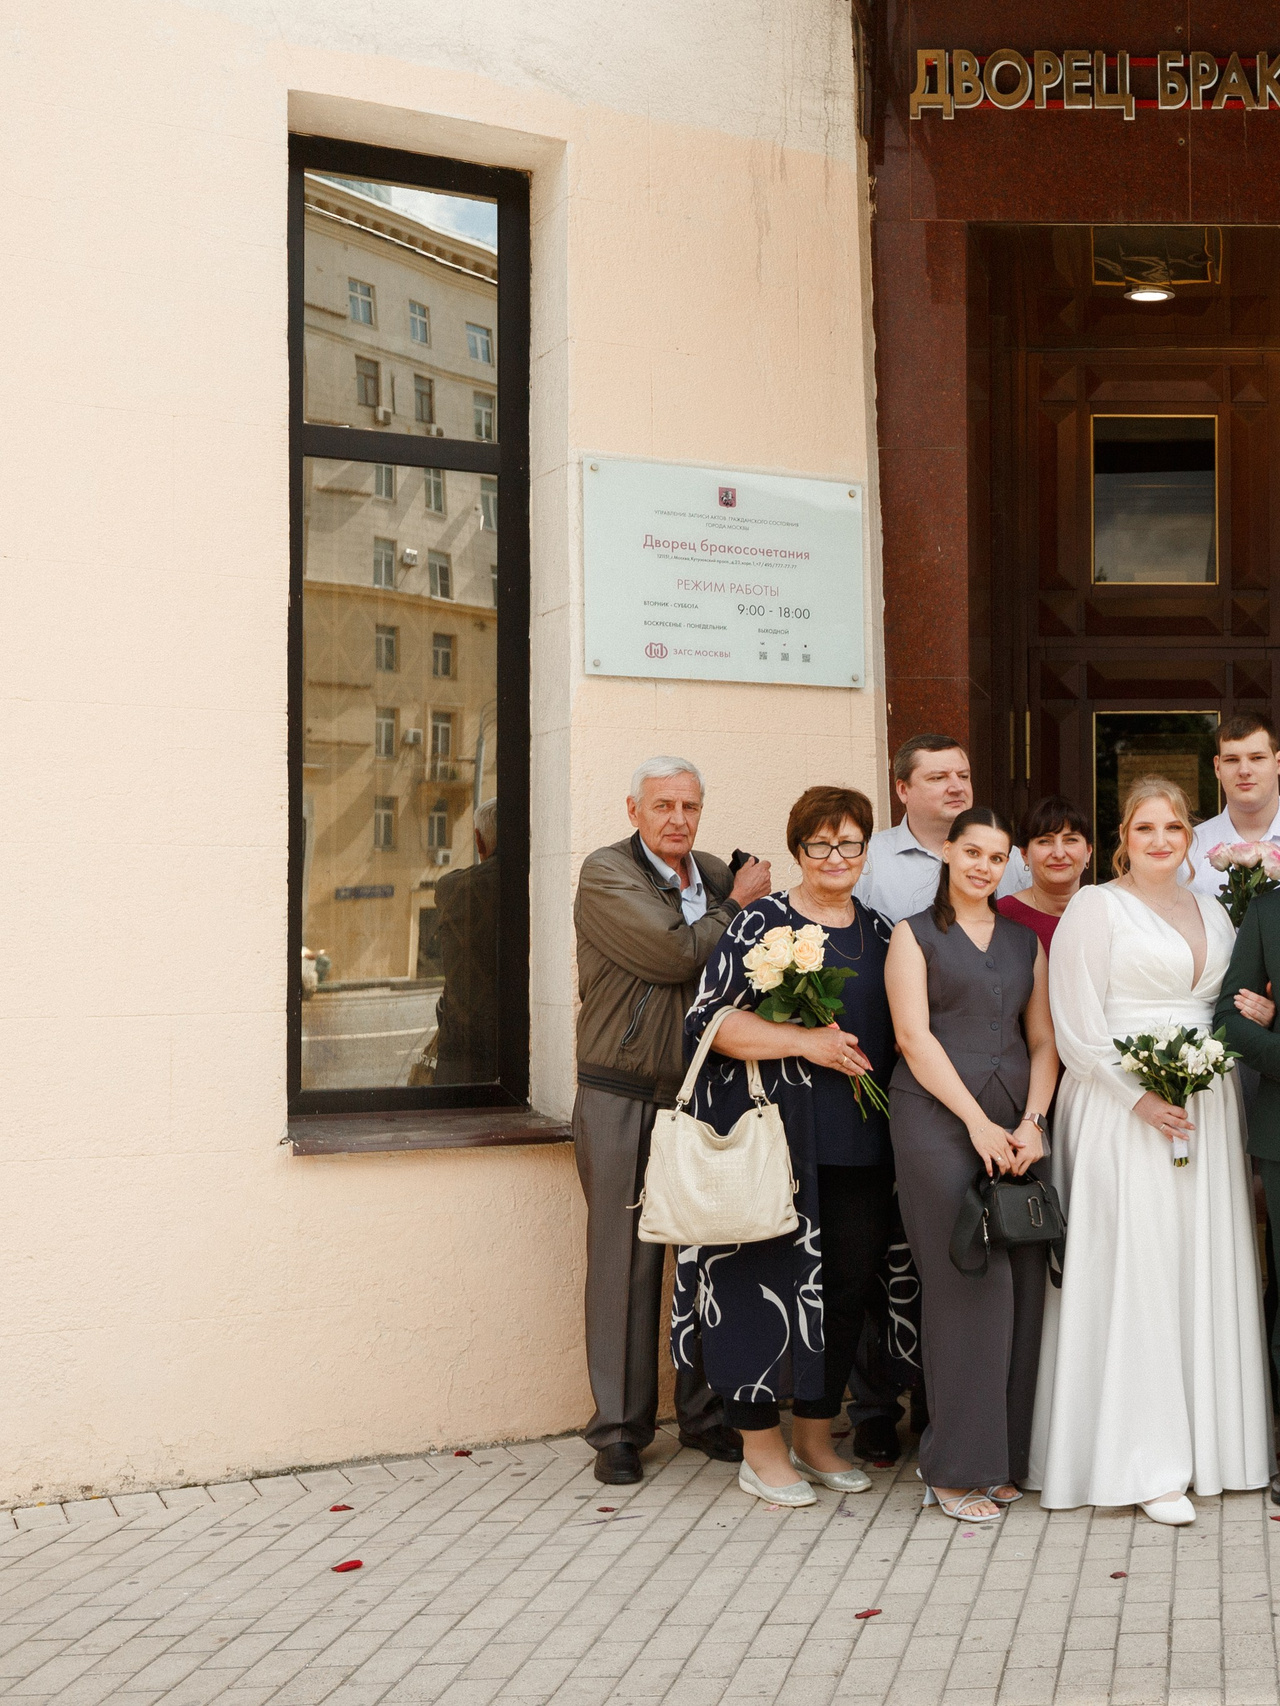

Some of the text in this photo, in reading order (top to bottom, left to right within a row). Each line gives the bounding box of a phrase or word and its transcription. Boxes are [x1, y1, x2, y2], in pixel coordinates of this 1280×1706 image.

[910, 49, 1135, 120] ДВОРЕЦ
[643, 534, 810, 561] Дворец бракосочетания
[677, 578, 779, 597] РЕЖИМ РАБОТЫ
[737, 603, 765, 616] 9:00
[778, 606, 811, 620] 18:00
[643, 620, 682, 628] ВОСКРЕСЕНЬЕ
[686, 622, 728, 630] ПОНЕДЕЛЬНИК
[673, 648, 731, 658] ЗАГС МОСКВЫ
